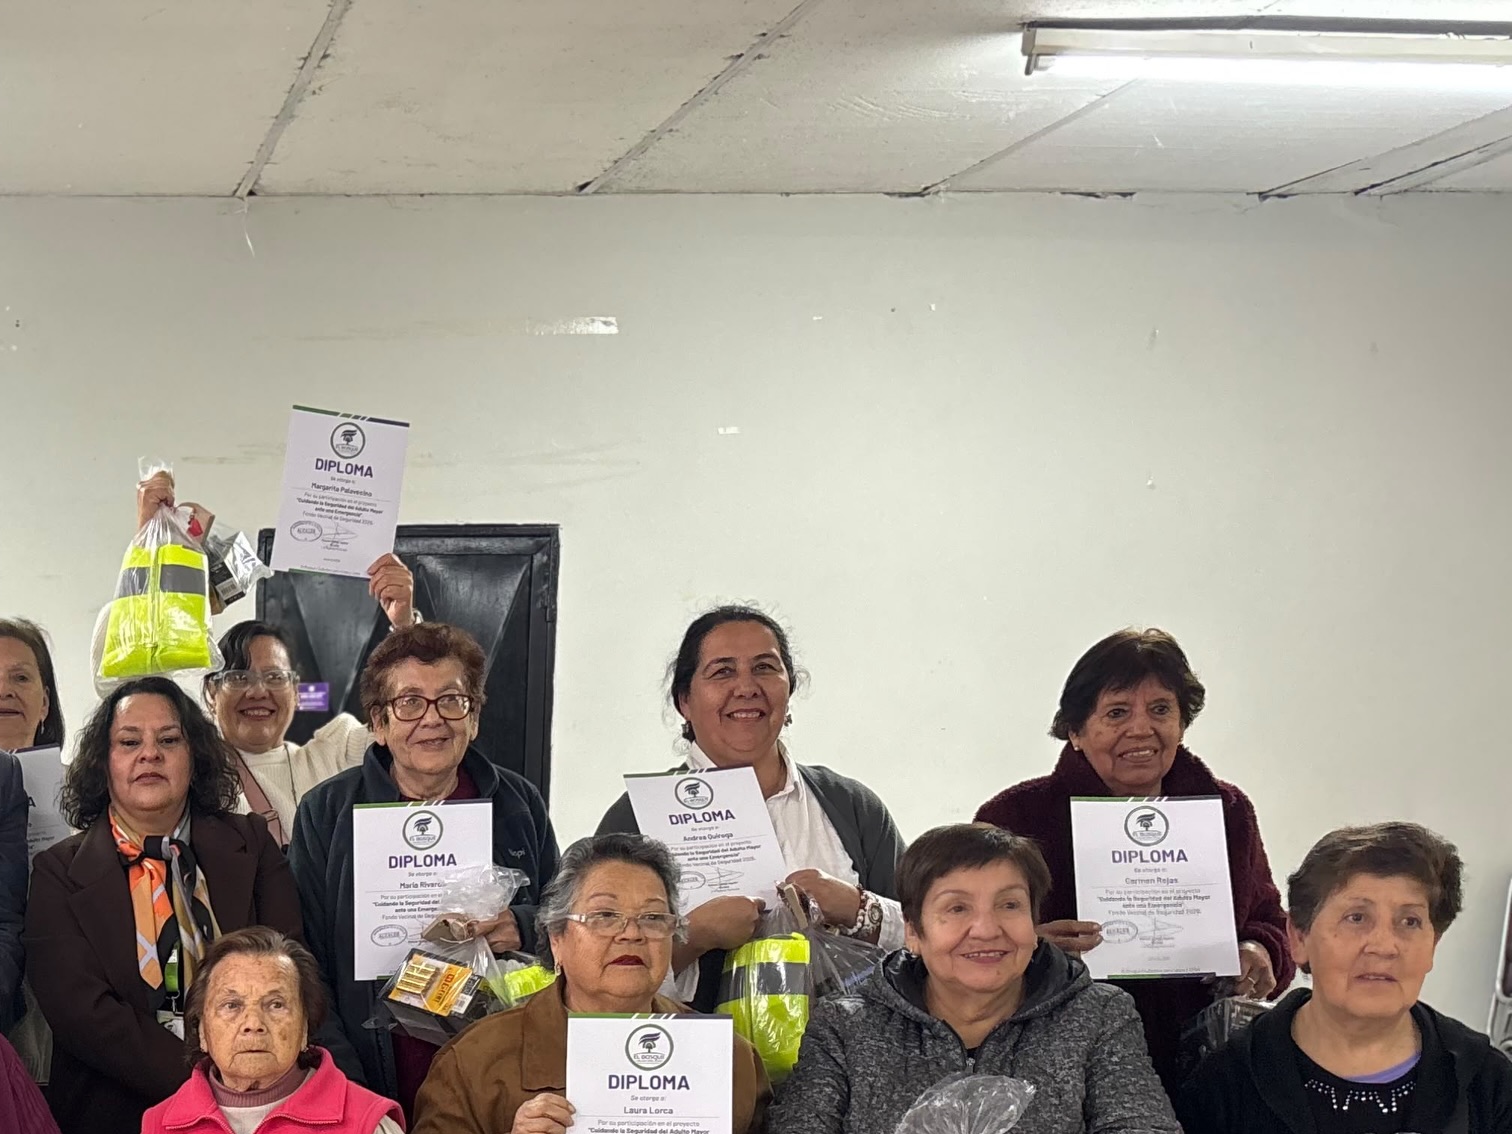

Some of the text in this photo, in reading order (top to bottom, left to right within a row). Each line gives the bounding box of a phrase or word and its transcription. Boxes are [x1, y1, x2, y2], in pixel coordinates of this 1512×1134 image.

[315, 458, 373, 478] DIPLOMA
[311, 483, 339, 493] Margarita
[669, 809, 735, 825] DIPLOMA
[708, 832, 733, 840] Quiroga
[389, 853, 457, 868] DIPLOMA
[1112, 849, 1188, 863] DIPLOMA
[1157, 877, 1178, 885] Rojas
[608, 1075, 690, 1090] DIPLOMA
[624, 1106, 673, 1114] Laura Lorca
